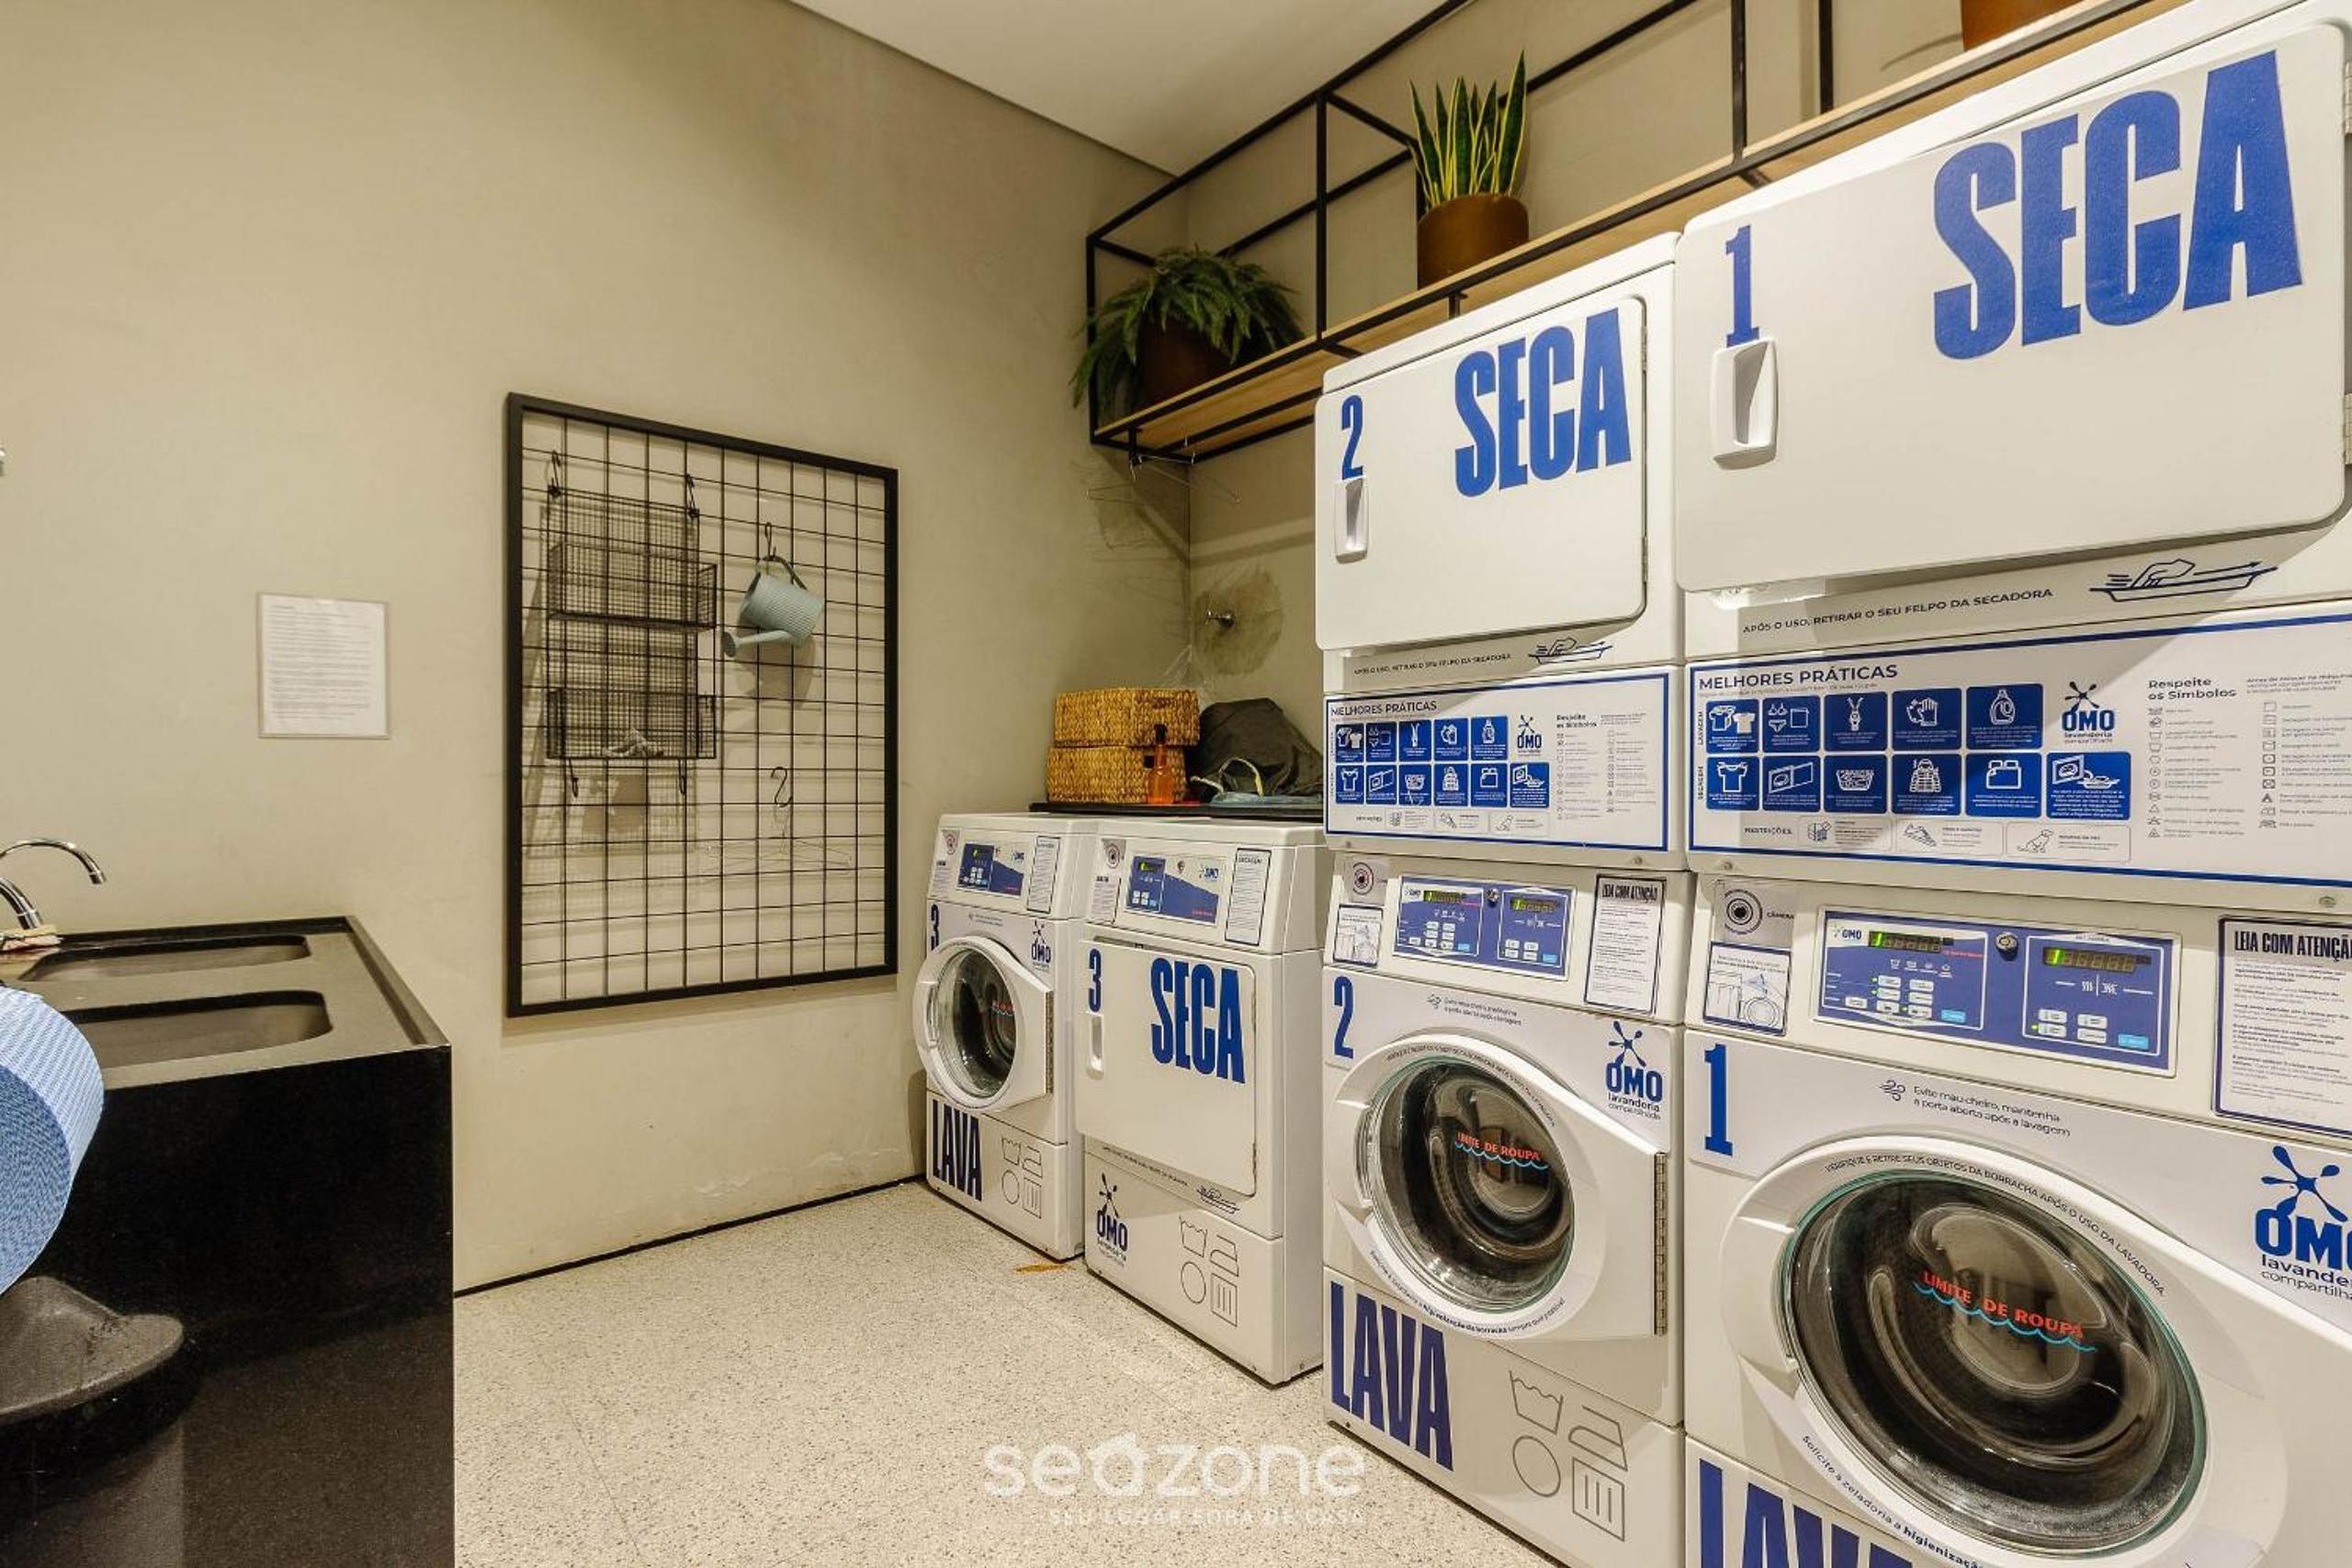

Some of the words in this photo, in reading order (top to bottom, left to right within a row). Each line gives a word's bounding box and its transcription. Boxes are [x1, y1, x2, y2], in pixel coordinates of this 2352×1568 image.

[1934, 51, 2302, 360] SECA
[1725, 225, 1759, 347] 1
[1455, 308, 1632, 497] SECA
[1341, 395, 1363, 480] 2
[1814, 611, 1862, 626] RETIRAR
[1866, 608, 1874, 619] O
[1878, 606, 1902, 617] SEU
[1905, 601, 1947, 615] FELPO
[1951, 598, 1971, 609] DA
[1973, 588, 2054, 606] SECADORA
[1699, 671, 1794, 690] MELHORES
[1799, 664, 1898, 684] PRÁTICAS
[2148, 676, 2212, 690] Respeite
[2148, 692, 2165, 700] os
[1331, 705, 1383, 717] MELHORES
[2061, 708, 2115, 732] OMO
[1517, 734, 1543, 750] OMO
[2233, 931, 2259, 953] LEIA
[2262, 932, 2294, 955] COM
[2296, 933, 2352, 963] ATENÇÃ
[1088, 948, 1102, 1012] 3
[1151, 958, 1246, 1084] SECA
[1334, 976, 1354, 1059] 2
[1605, 1062, 1663, 1102] OMO
[1704, 1043, 1733, 1156] 1
[1914, 1086, 1938, 1099] Evite
[2002, 1104, 2060, 1122] mantenha
[1921, 1100, 1948, 1112] porta
[1950, 1104, 1983, 1119] aberta
[1984, 1112, 2011, 1126] após
[2020, 1118, 2071, 1137] lavagem
[933, 1100, 982, 1202] LAVA
[1485, 1142, 1498, 1155] DE
[1500, 1145, 1541, 1161] ROUPA
[1097, 1210, 1127, 1251] OMO
[1903, 1155, 1925, 1164] SEUS
[1969, 1166, 1983, 1176] DA
[1984, 1170, 2038, 1196] BORRACHA
[2041, 1192, 2067, 1213] APÓS
[2069, 1209, 2077, 1218] O
[2079, 1214, 2099, 1233] USO
[2100, 1230, 2115, 1247] DA
[2115, 1243, 2167, 1296] LAVADORA
[2256, 1208, 2352, 1270] OM
[2261, 1254, 2352, 1287] lavande
[1921, 1269, 1972, 1303] LIMITE
[1982, 1296, 2008, 1317] DE
[2015, 1308, 2084, 1339] ROUPA
[1331, 1280, 1453, 1472] LAVA
[1803, 1435, 1836, 1474] Solicite
[1843, 1481, 1894, 1525] zeladoria
[1894, 1521, 1901, 1529] a
[1903, 1526, 1984, 1568] higienizaçã
